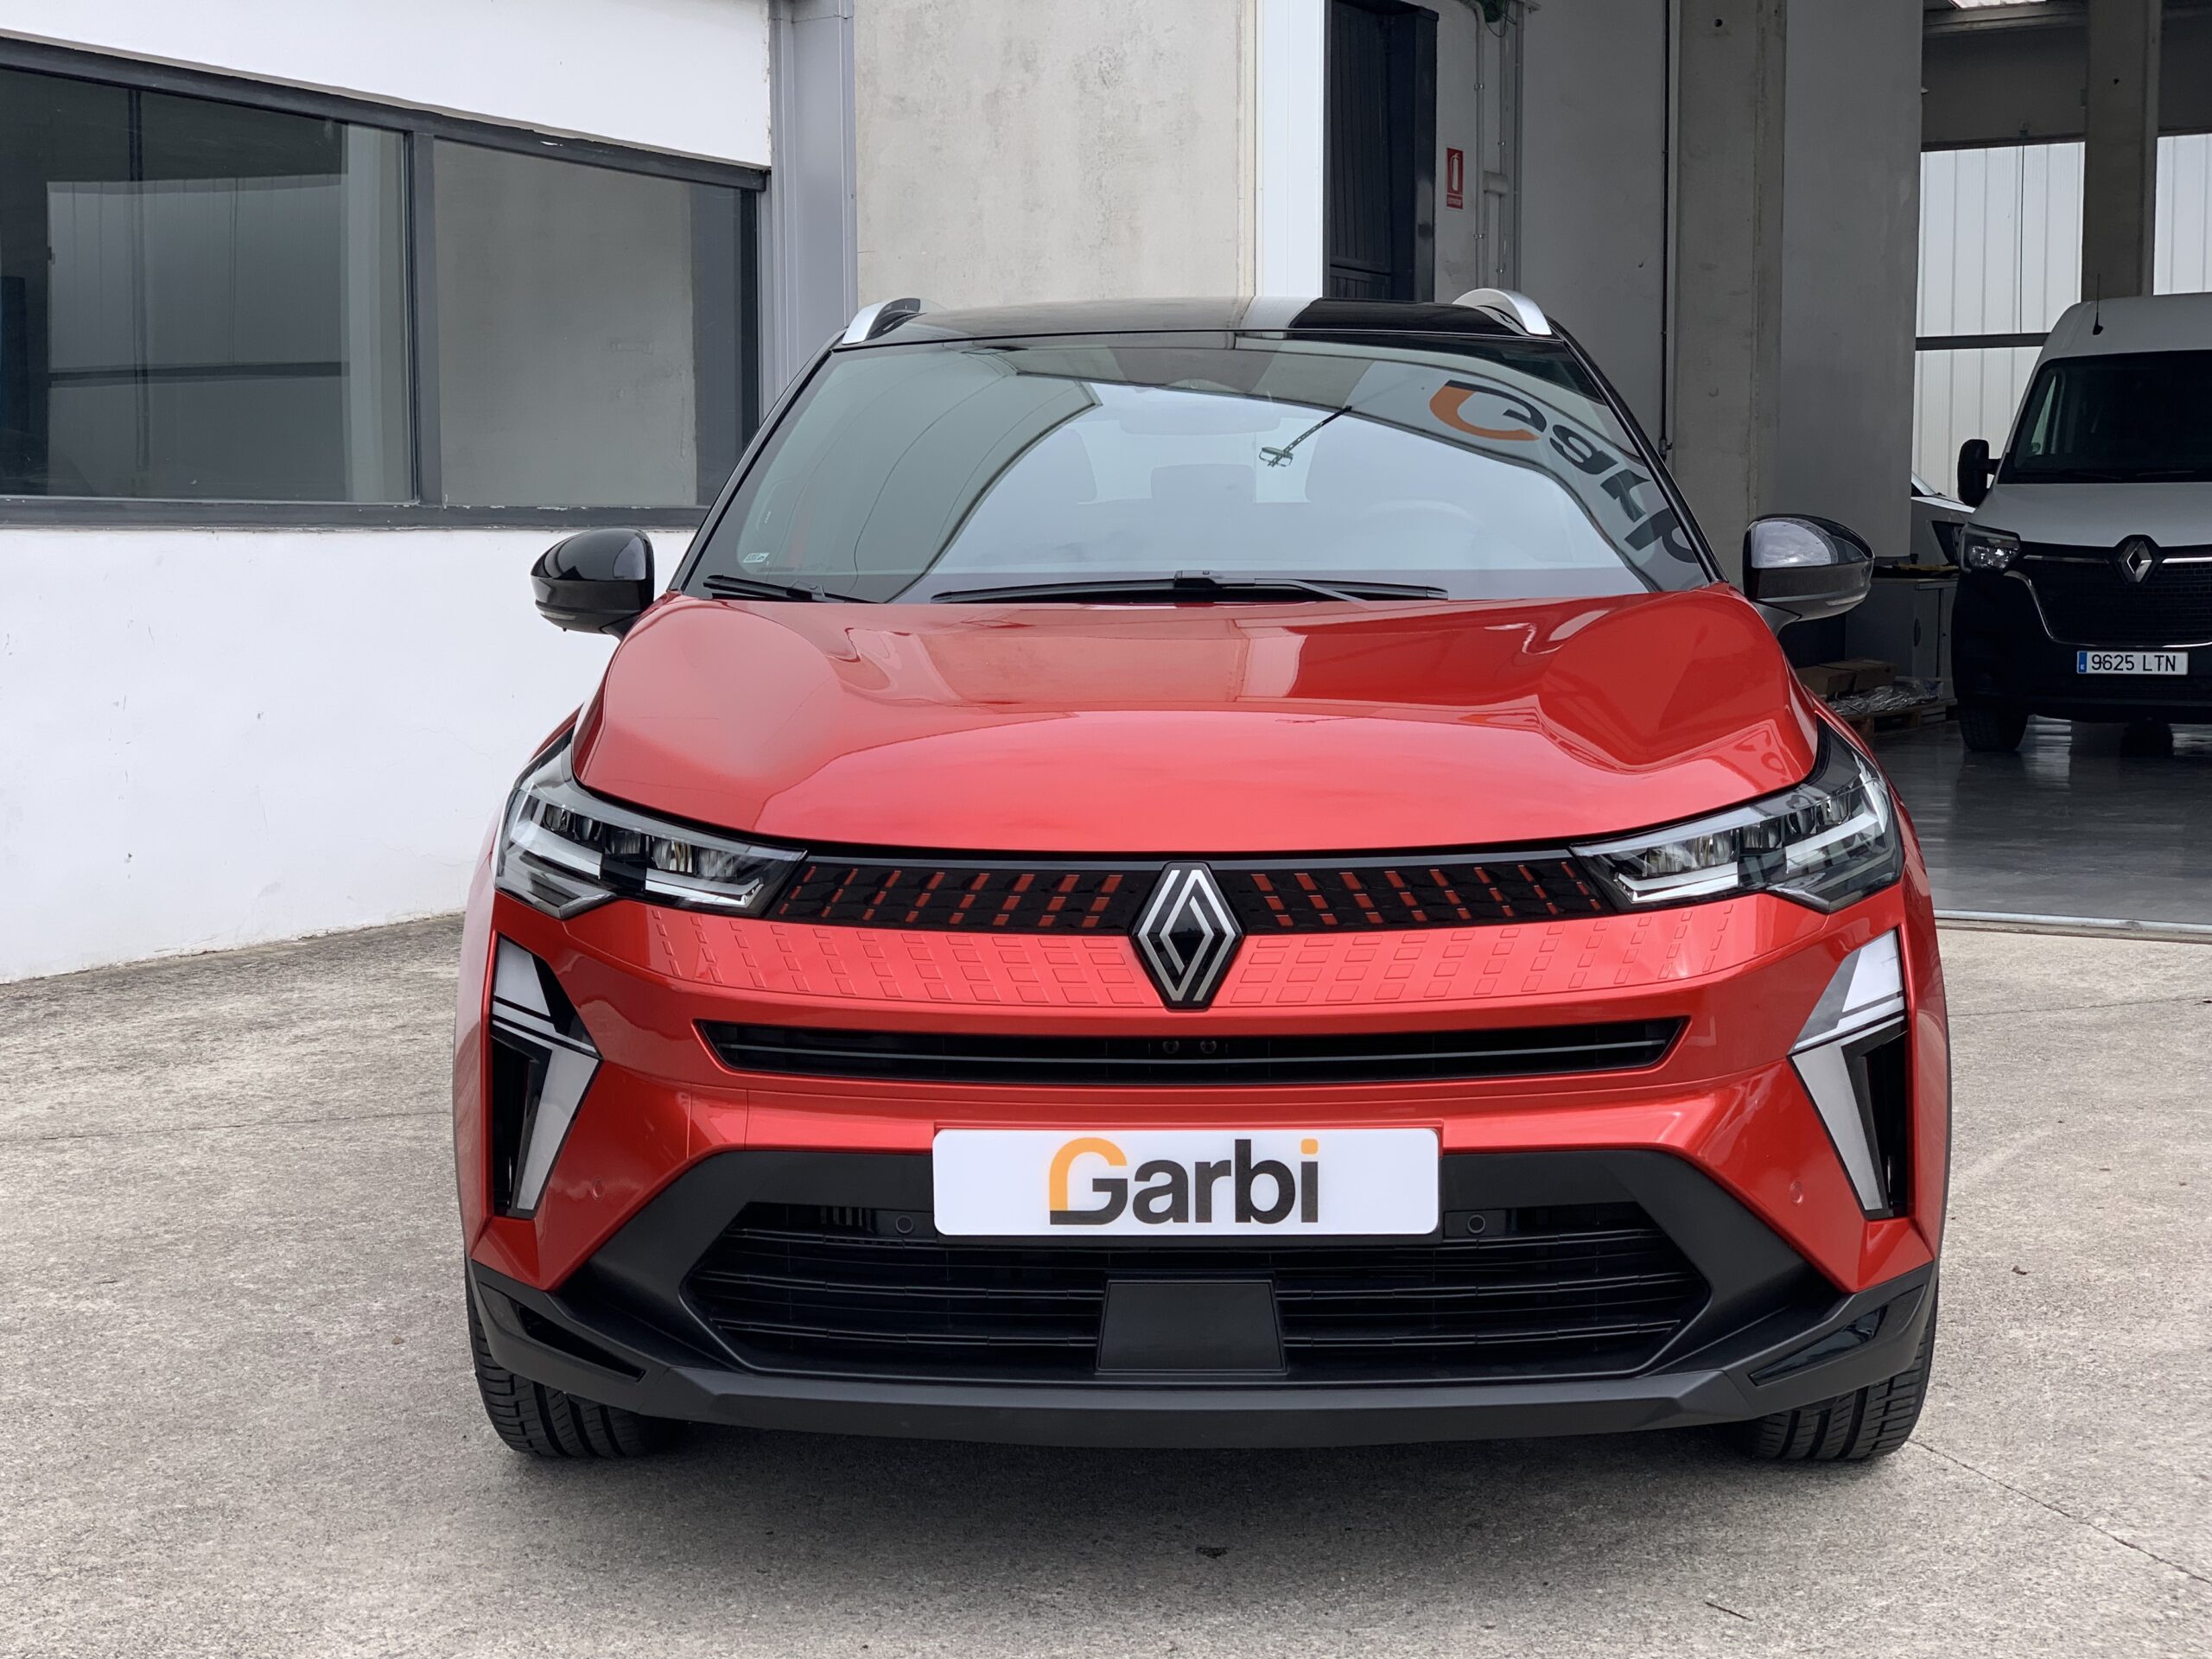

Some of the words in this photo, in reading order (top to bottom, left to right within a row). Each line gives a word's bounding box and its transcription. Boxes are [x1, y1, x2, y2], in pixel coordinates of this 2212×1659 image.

[2091, 654, 2135, 671] 9625
[2142, 654, 2177, 672] LTN
[1048, 1136, 1319, 1226] Garbi
